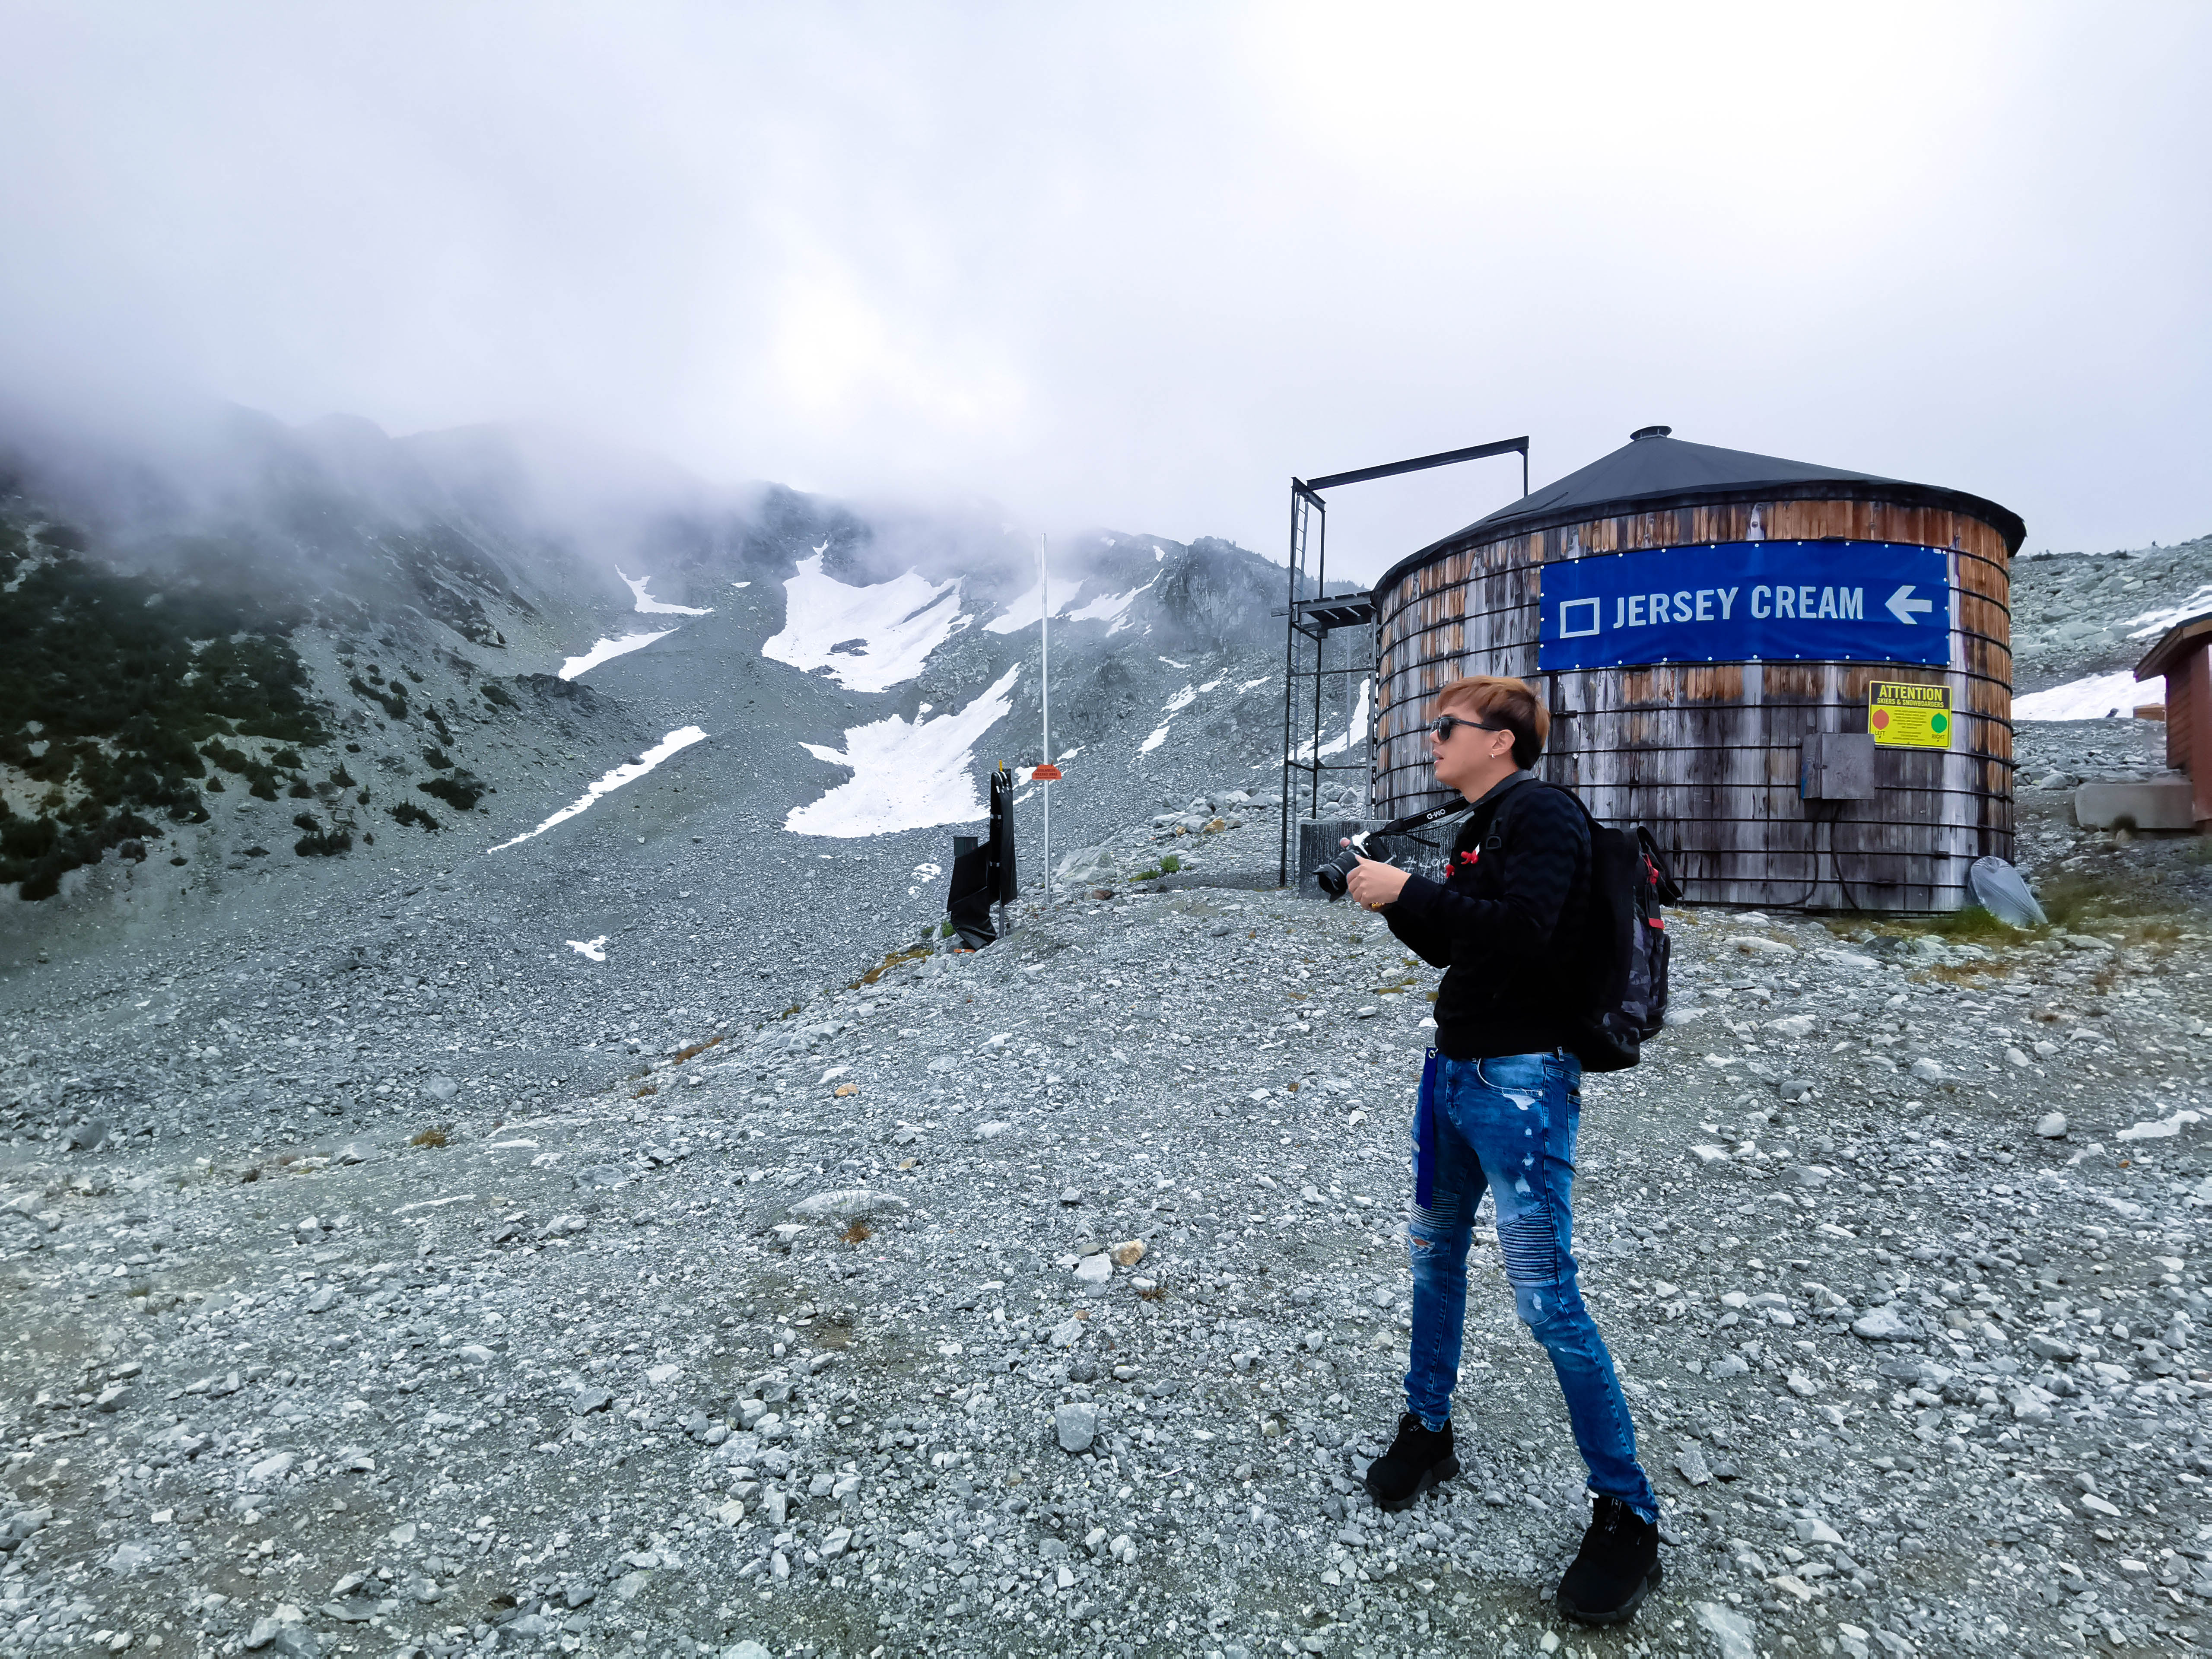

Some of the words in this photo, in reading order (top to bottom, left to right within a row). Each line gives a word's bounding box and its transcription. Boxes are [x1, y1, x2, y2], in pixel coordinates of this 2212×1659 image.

[1613, 587, 1739, 629] JERSEY
[1751, 585, 1863, 619] CREAM
[1879, 685, 1942, 701] ATTENTION
[1903, 699, 1944, 708] SNOWBOARDERS
[1427, 809, 1446, 820] OM-D
